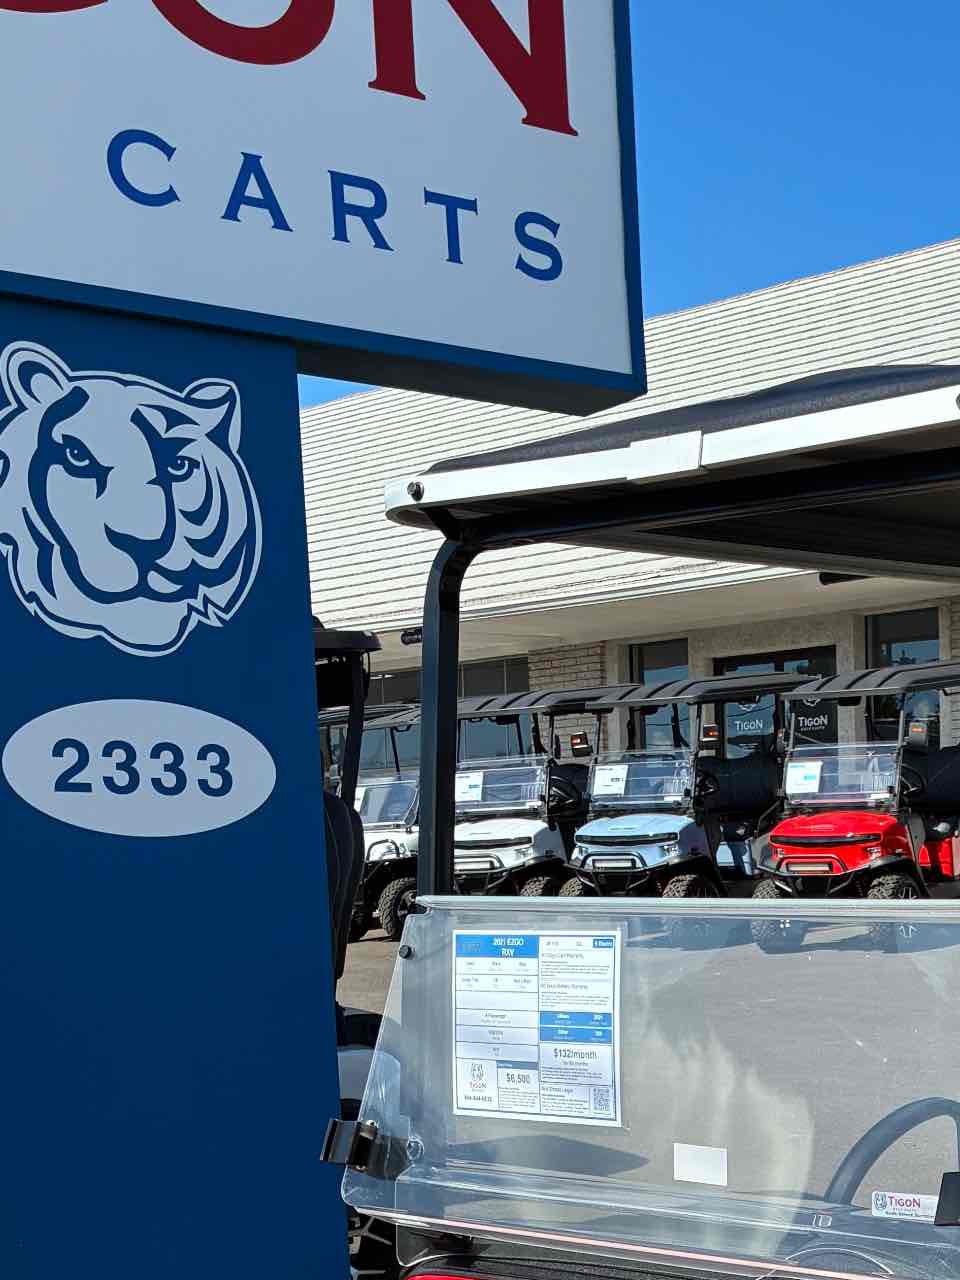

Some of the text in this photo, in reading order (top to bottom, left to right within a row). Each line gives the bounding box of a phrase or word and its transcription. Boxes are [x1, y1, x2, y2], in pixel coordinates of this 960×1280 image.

[106, 129, 563, 281] CARTS
[734, 719, 763, 732] TIGON
[797, 714, 829, 727] TIGON
[51, 738, 233, 797] 2333
[887, 1196, 921, 1208] TIGON
